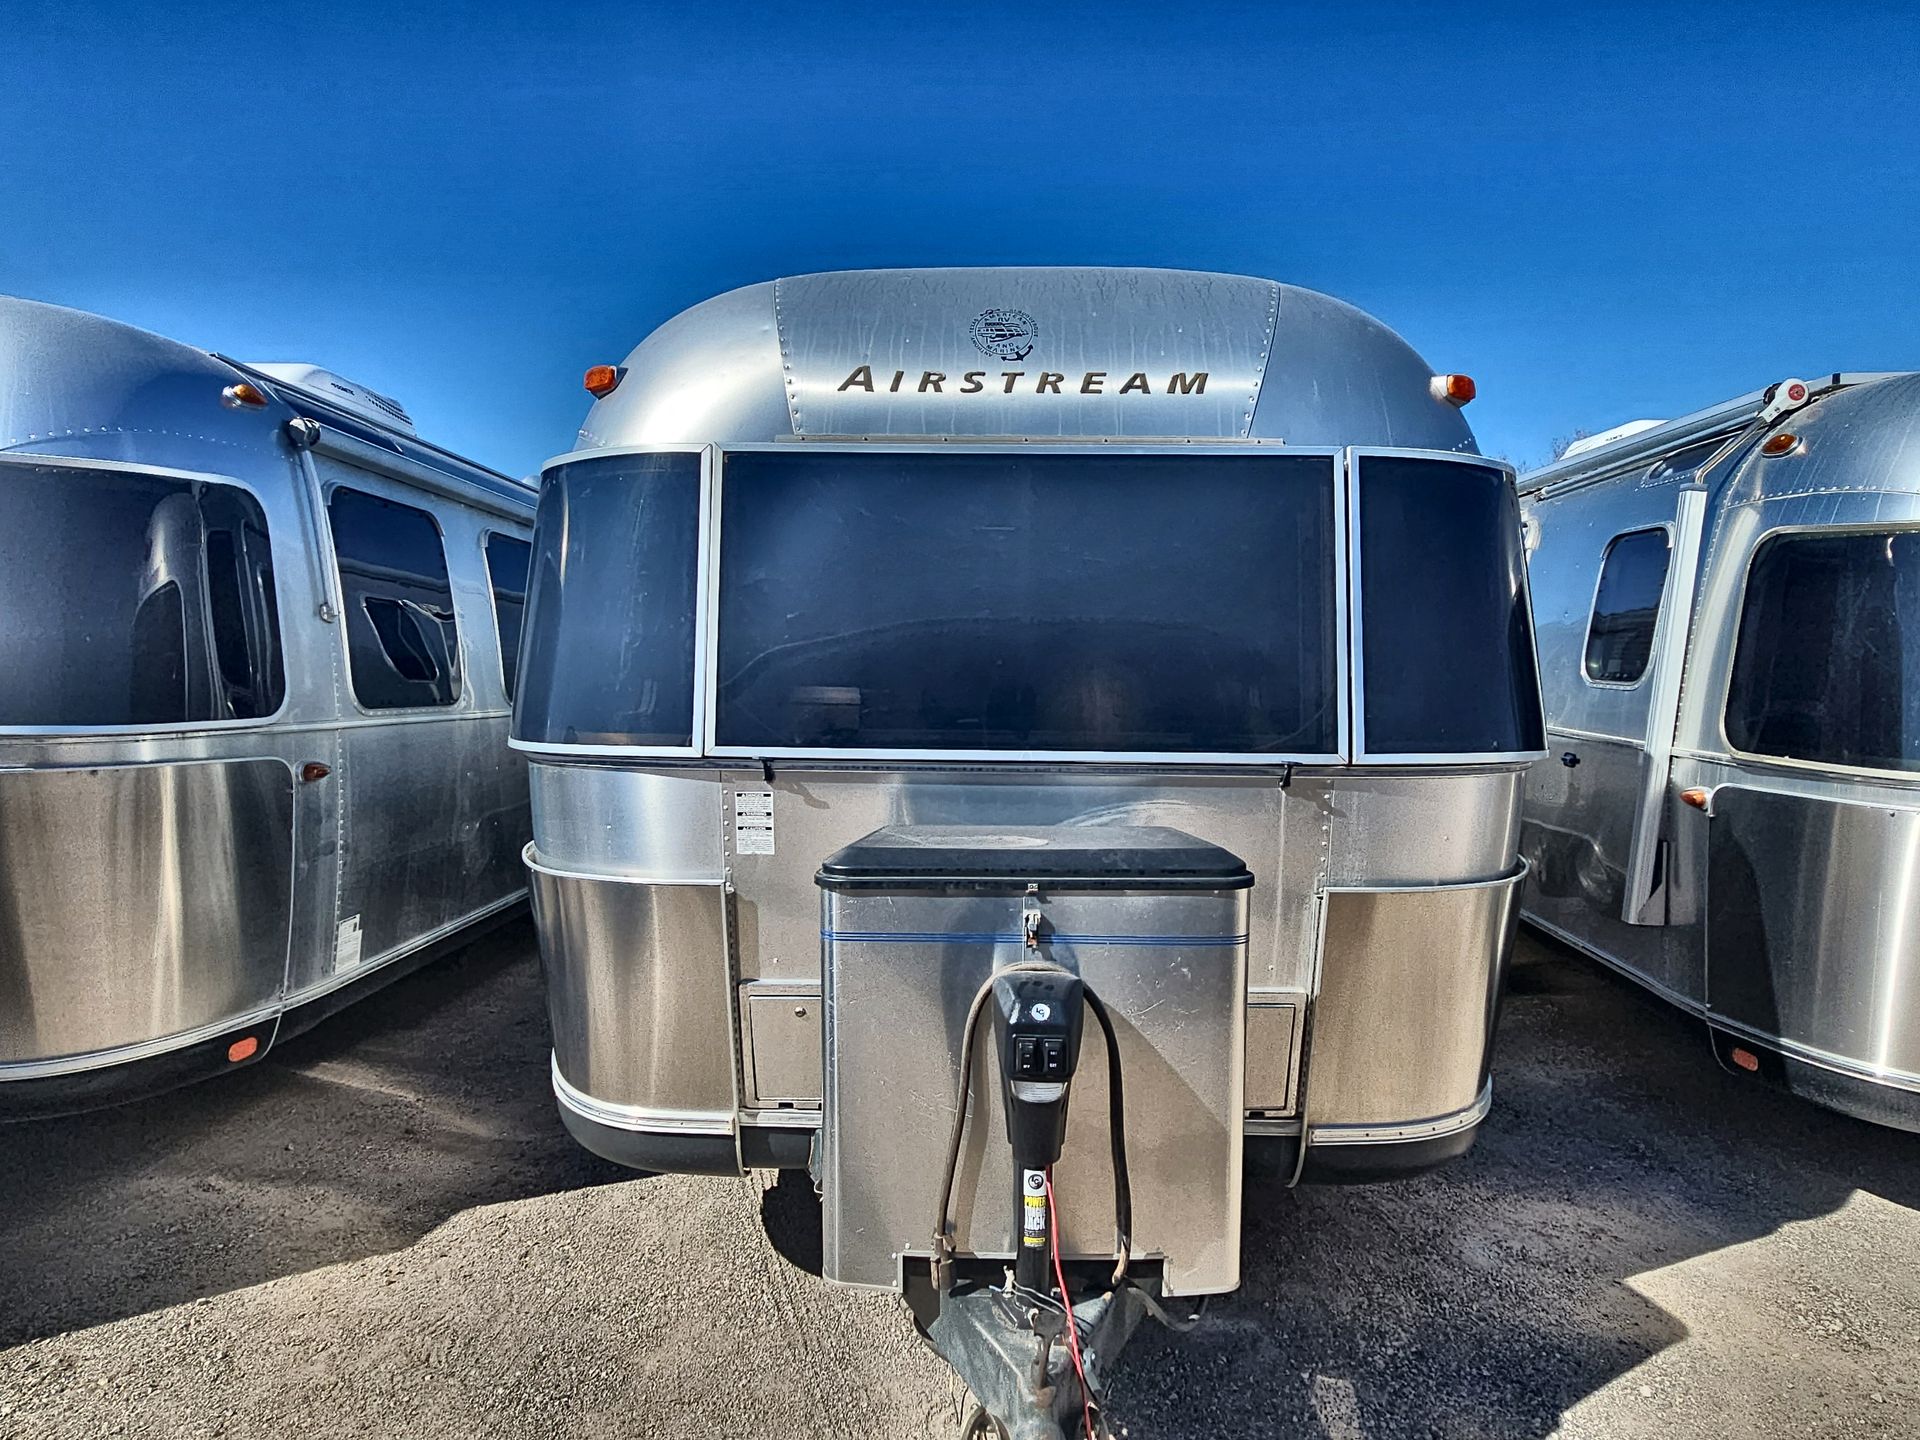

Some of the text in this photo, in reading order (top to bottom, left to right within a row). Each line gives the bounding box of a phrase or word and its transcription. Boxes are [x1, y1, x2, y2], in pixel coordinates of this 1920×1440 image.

[984, 312, 1028, 326] AMERICAN
[986, 345, 1021, 354] MARINE
[837, 365, 1209, 395] AIRSTREAM
